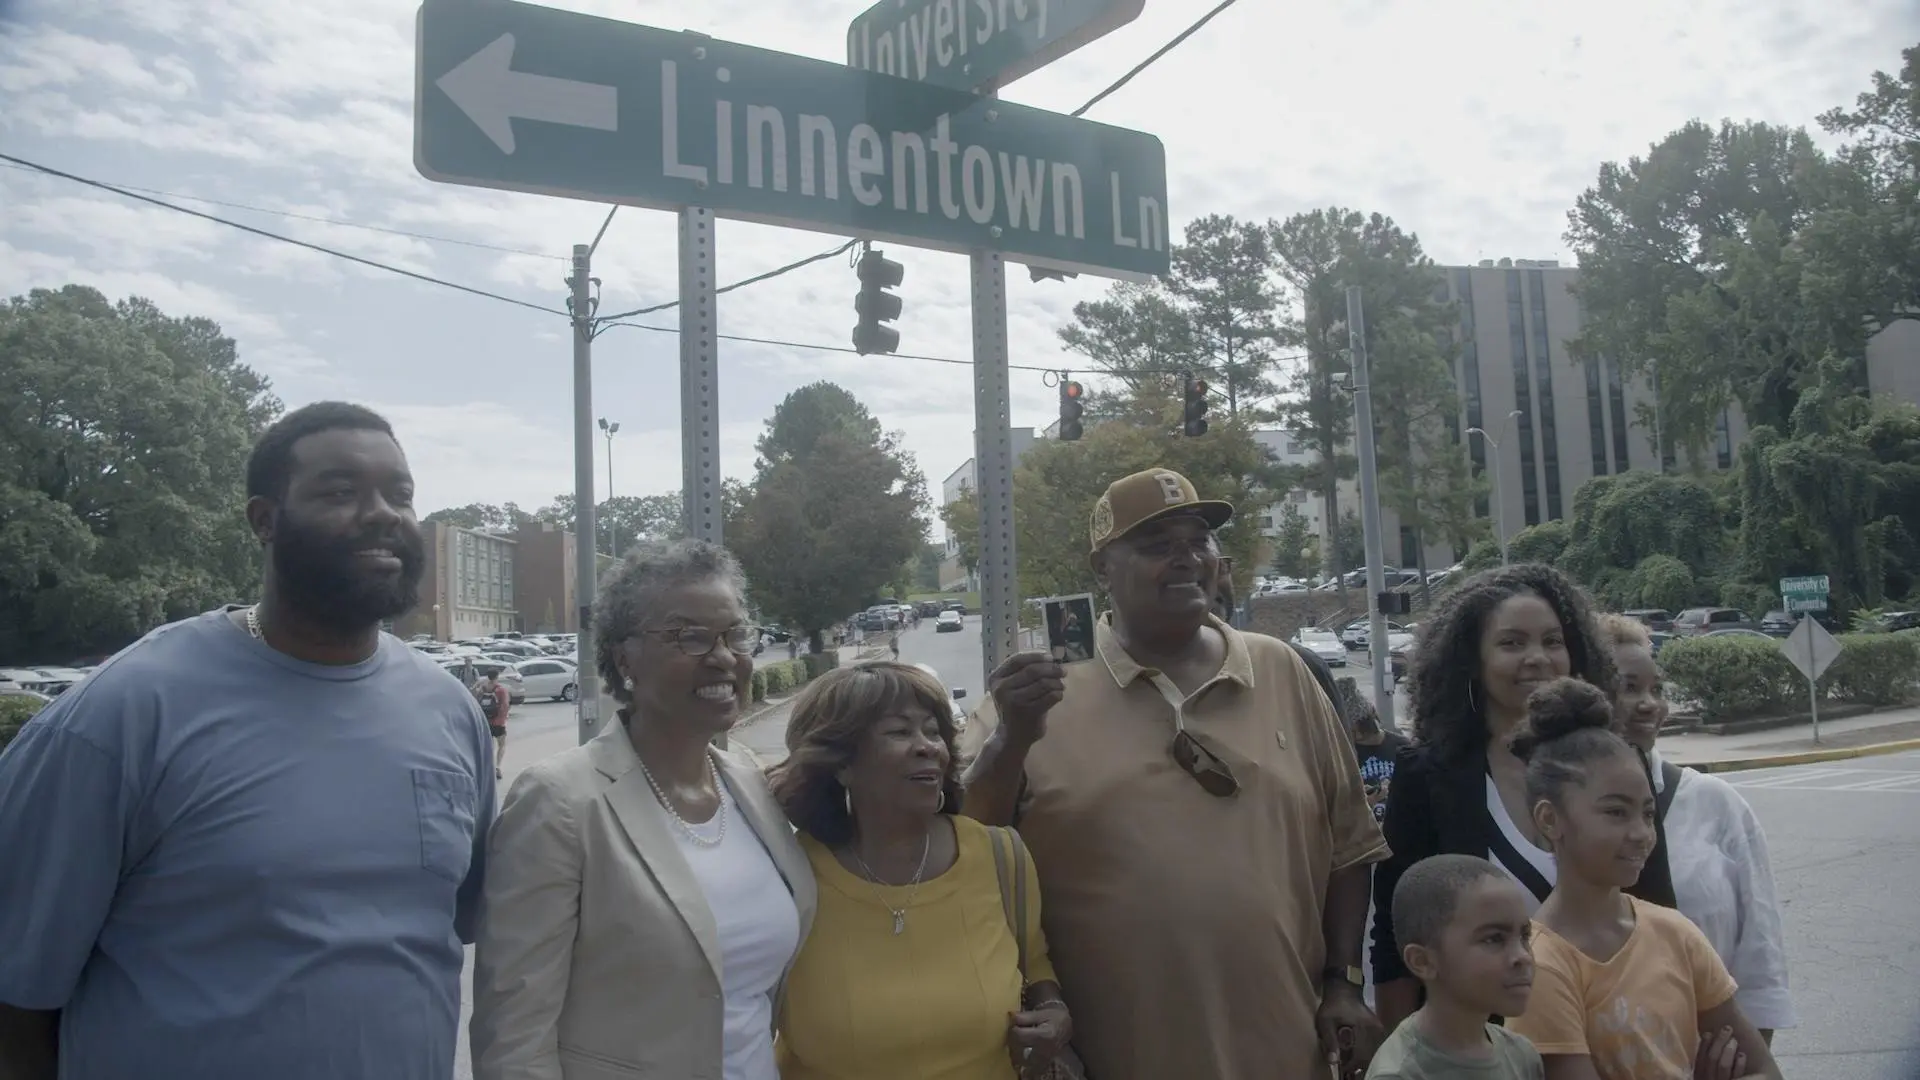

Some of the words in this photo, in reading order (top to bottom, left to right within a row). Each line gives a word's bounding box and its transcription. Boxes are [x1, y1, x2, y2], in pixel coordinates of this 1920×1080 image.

[850, 0, 1048, 81] Univers
[661, 60, 1085, 240] Linnentown
[1110, 171, 1162, 251] Ln
[1153, 473, 1186, 505] B
